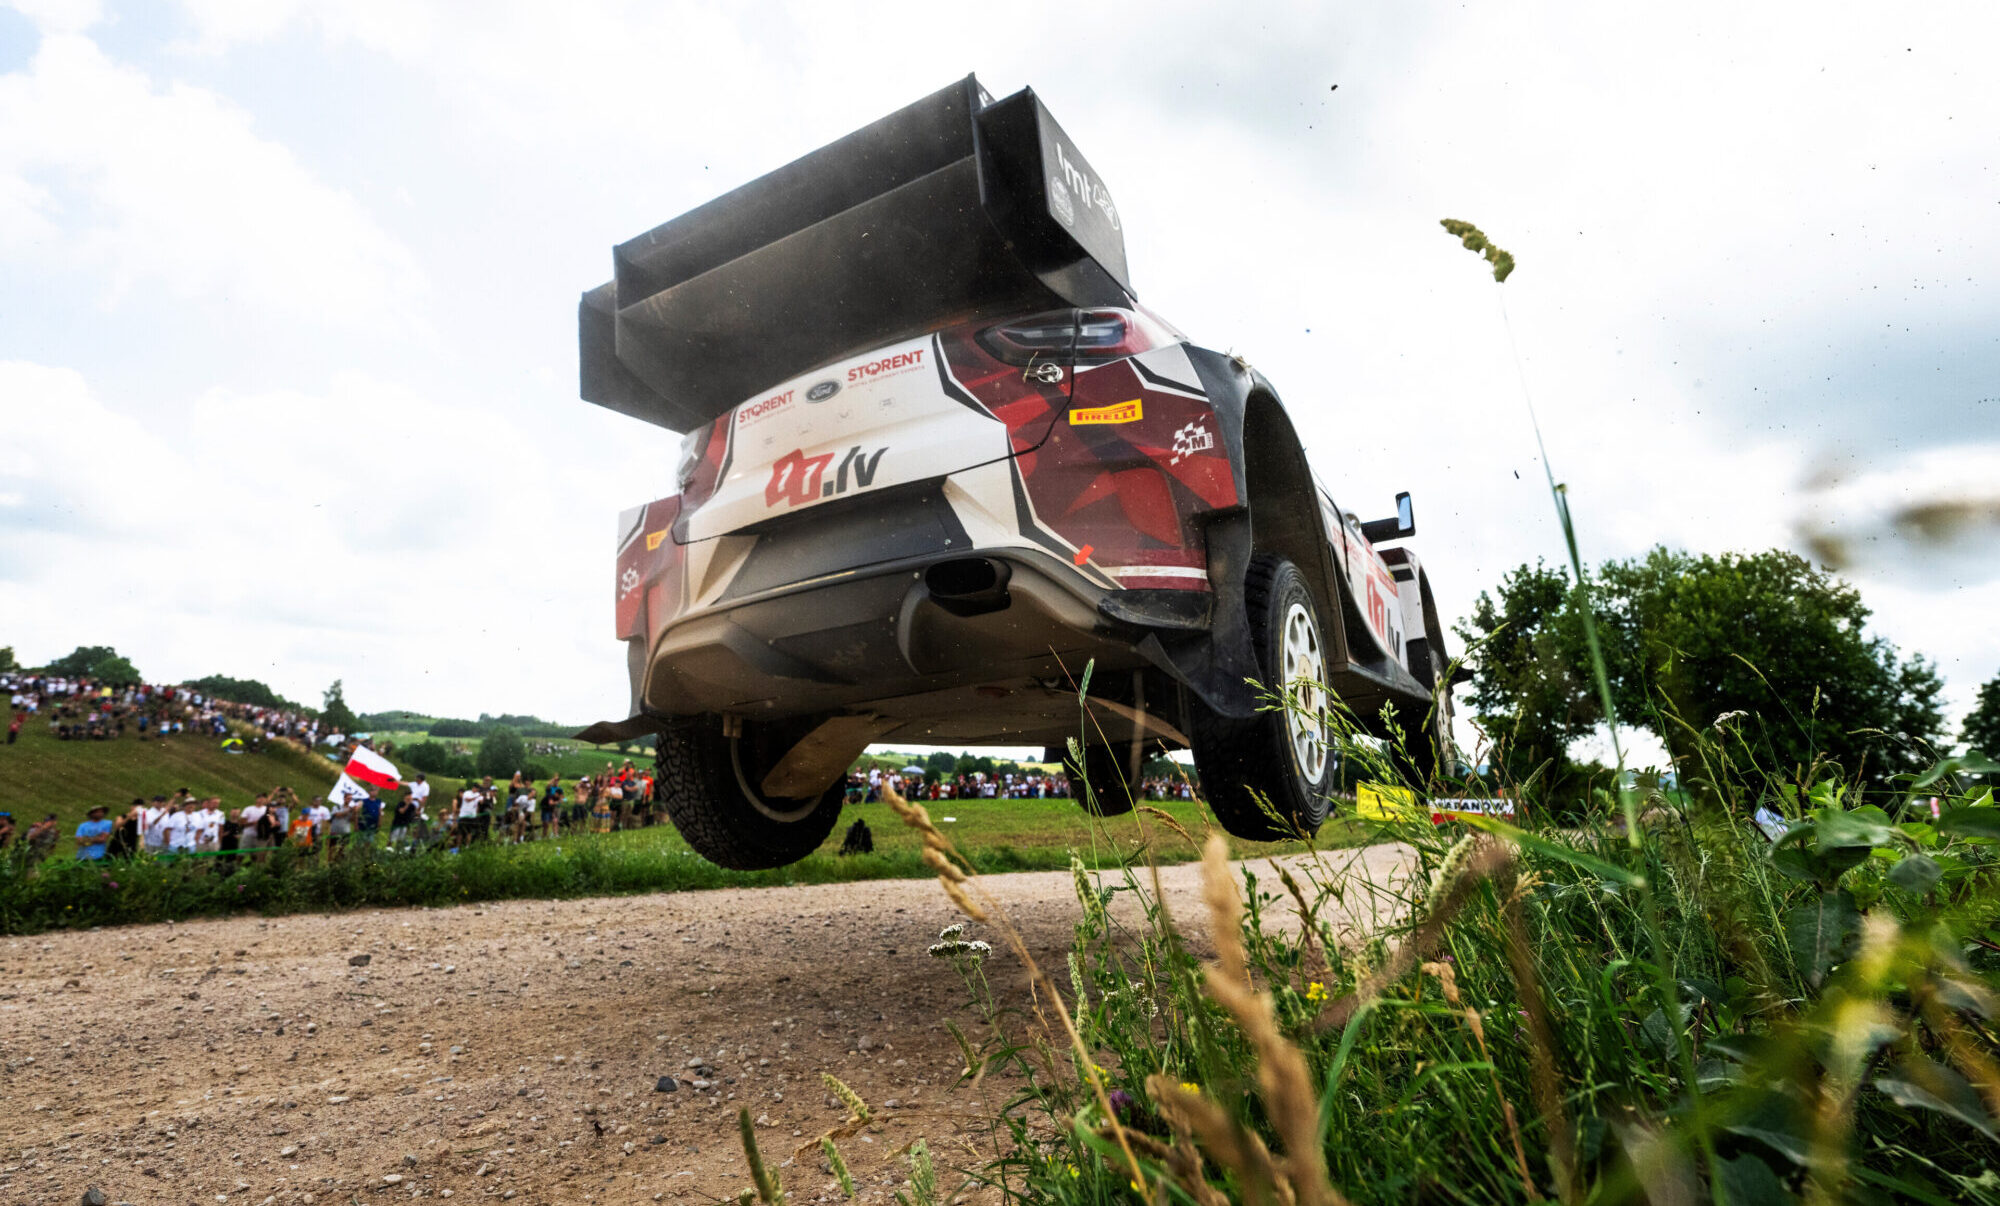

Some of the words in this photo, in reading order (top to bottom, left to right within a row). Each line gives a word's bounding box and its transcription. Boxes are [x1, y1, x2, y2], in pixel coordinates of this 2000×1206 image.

[848, 349, 924, 382] STORENT
[811, 384, 833, 399] Ford
[739, 390, 795, 424] STORENT
[1076, 405, 1136, 421] PIRELLI
